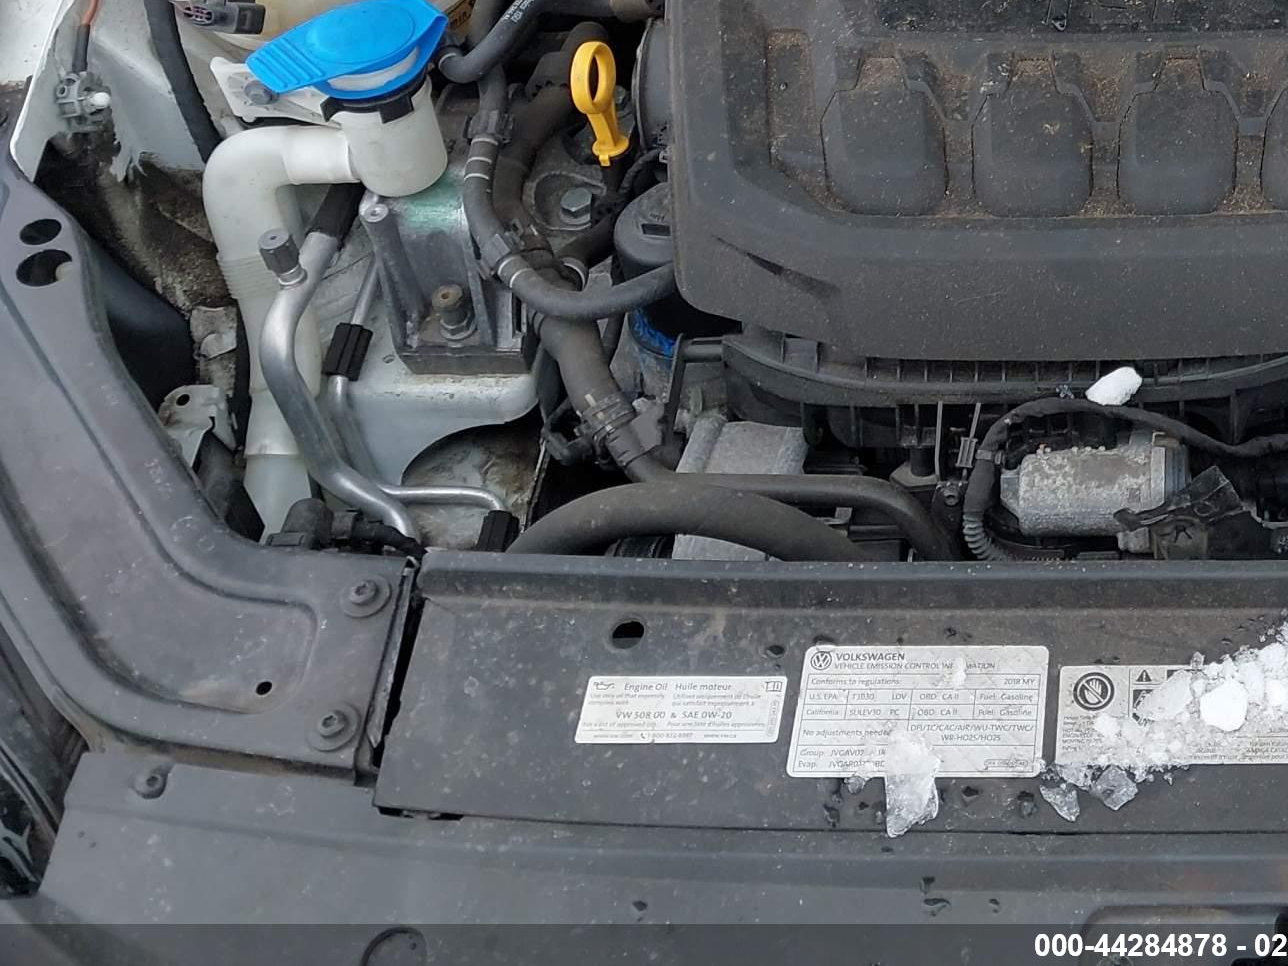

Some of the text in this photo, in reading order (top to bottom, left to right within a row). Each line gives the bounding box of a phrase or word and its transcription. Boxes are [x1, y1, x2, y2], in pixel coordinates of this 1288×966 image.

[836, 652, 905, 661] VOLKSWAGEN
[624, 682, 669, 693] Engine Oil
[674, 682, 732, 691] Huile moteur
[1000, 693, 1033, 701] Gasoline
[616, 711, 633, 719] VW
[634, 711, 652, 719] 508
[653, 711, 666, 719] 00
[682, 711, 699, 719] SAE
[701, 711, 733, 719] 0W-20
[816, 729, 862, 737] adjustments
